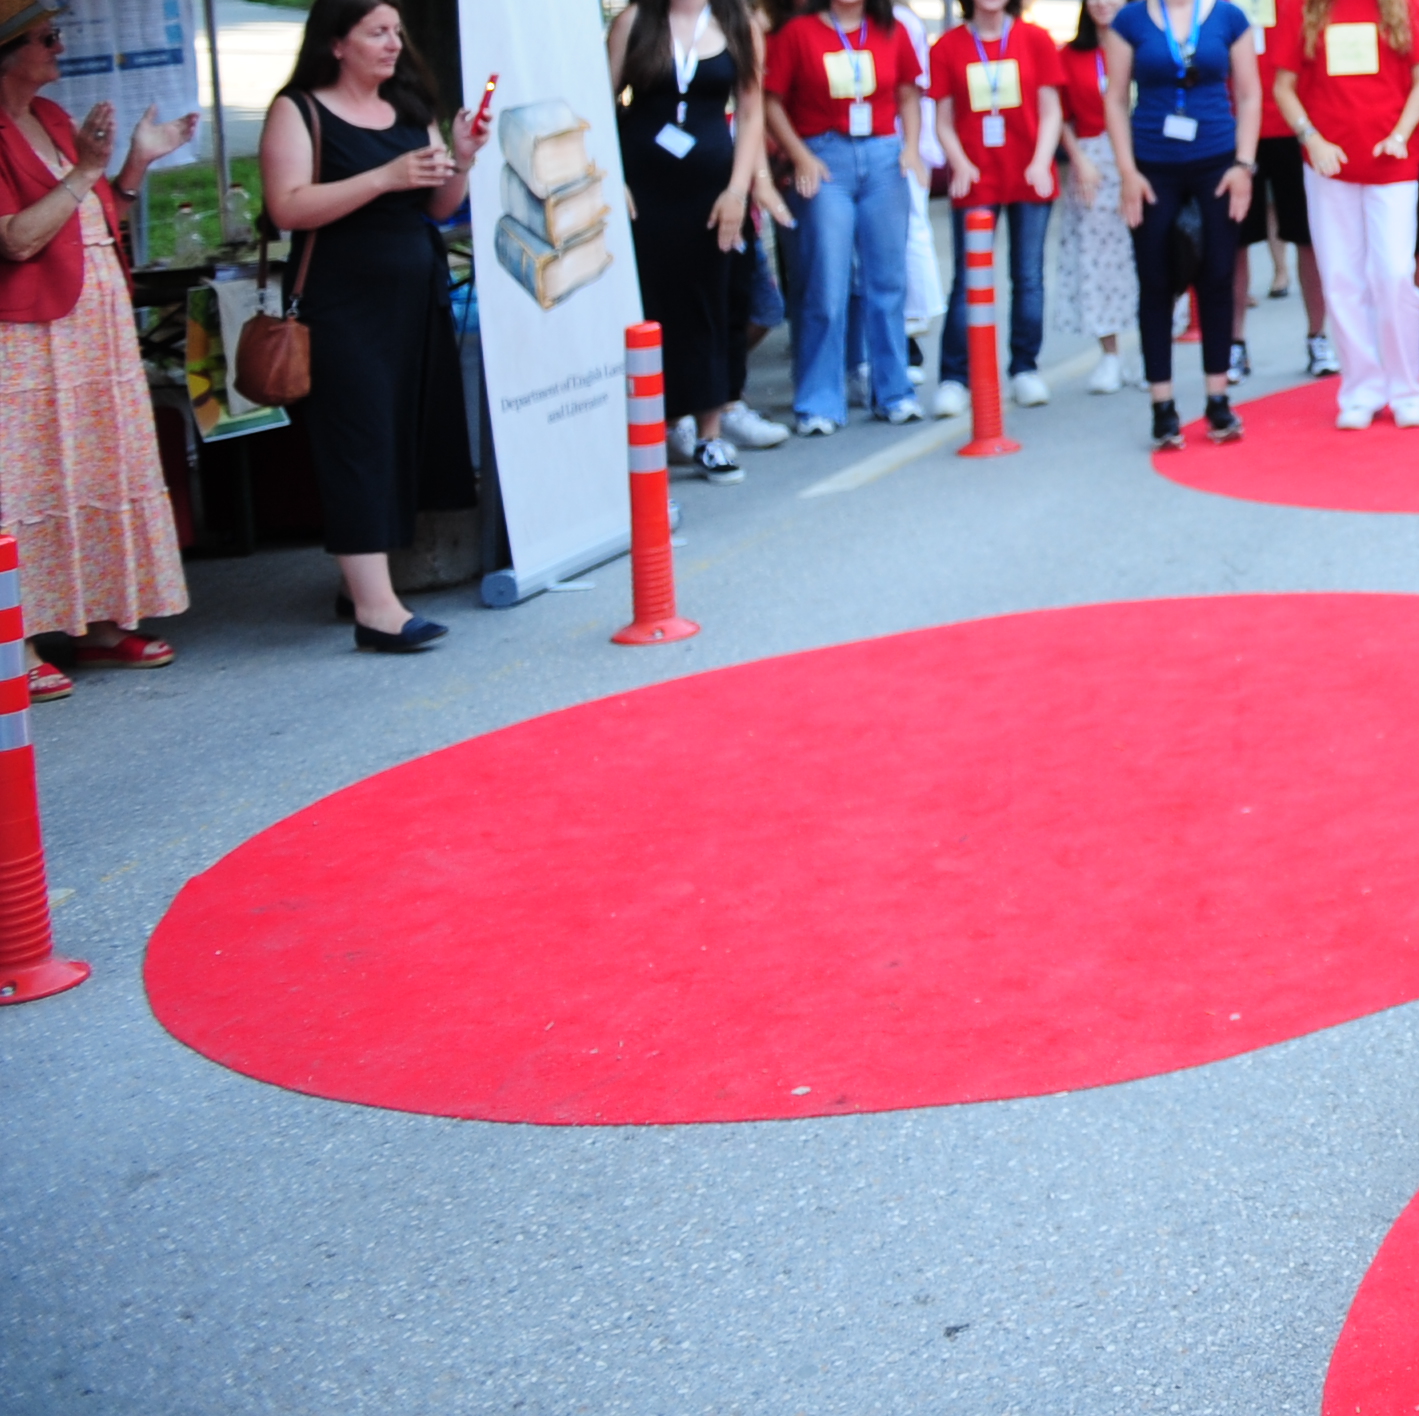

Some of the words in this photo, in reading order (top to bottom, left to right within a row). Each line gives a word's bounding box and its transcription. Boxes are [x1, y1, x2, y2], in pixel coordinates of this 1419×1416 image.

[500, 383, 559, 413] Department
[560, 377, 571, 392] of
[571, 367, 602, 388] English
